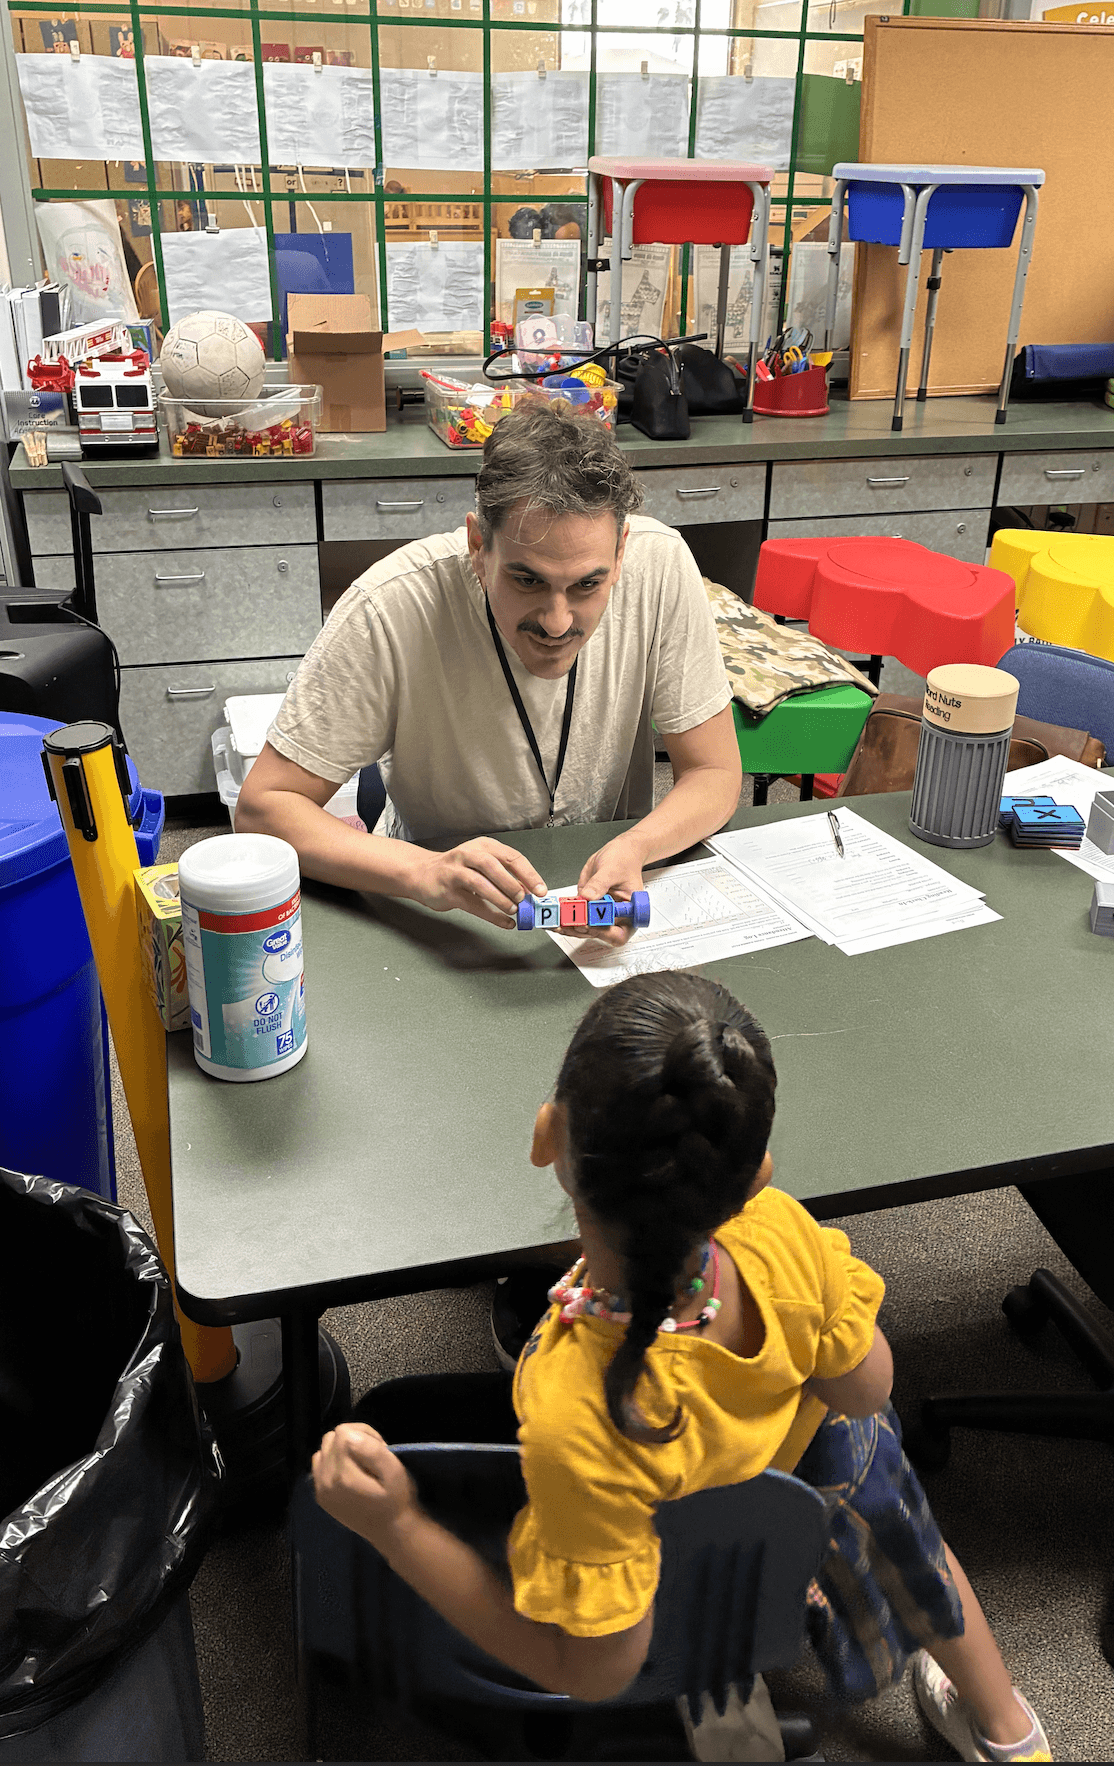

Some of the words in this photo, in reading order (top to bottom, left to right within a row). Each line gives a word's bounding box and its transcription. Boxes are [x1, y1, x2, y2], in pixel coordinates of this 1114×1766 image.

[939, 693, 962, 708] Nuts
[266, 932, 287, 947] Great
[272, 939, 288, 951] Value
[253, 1018, 266, 1028] DO
[268, 1012, 283, 1024] NOT
[256, 1021, 282, 1035] FLUSH
[278, 1031, 293, 1048] 75
